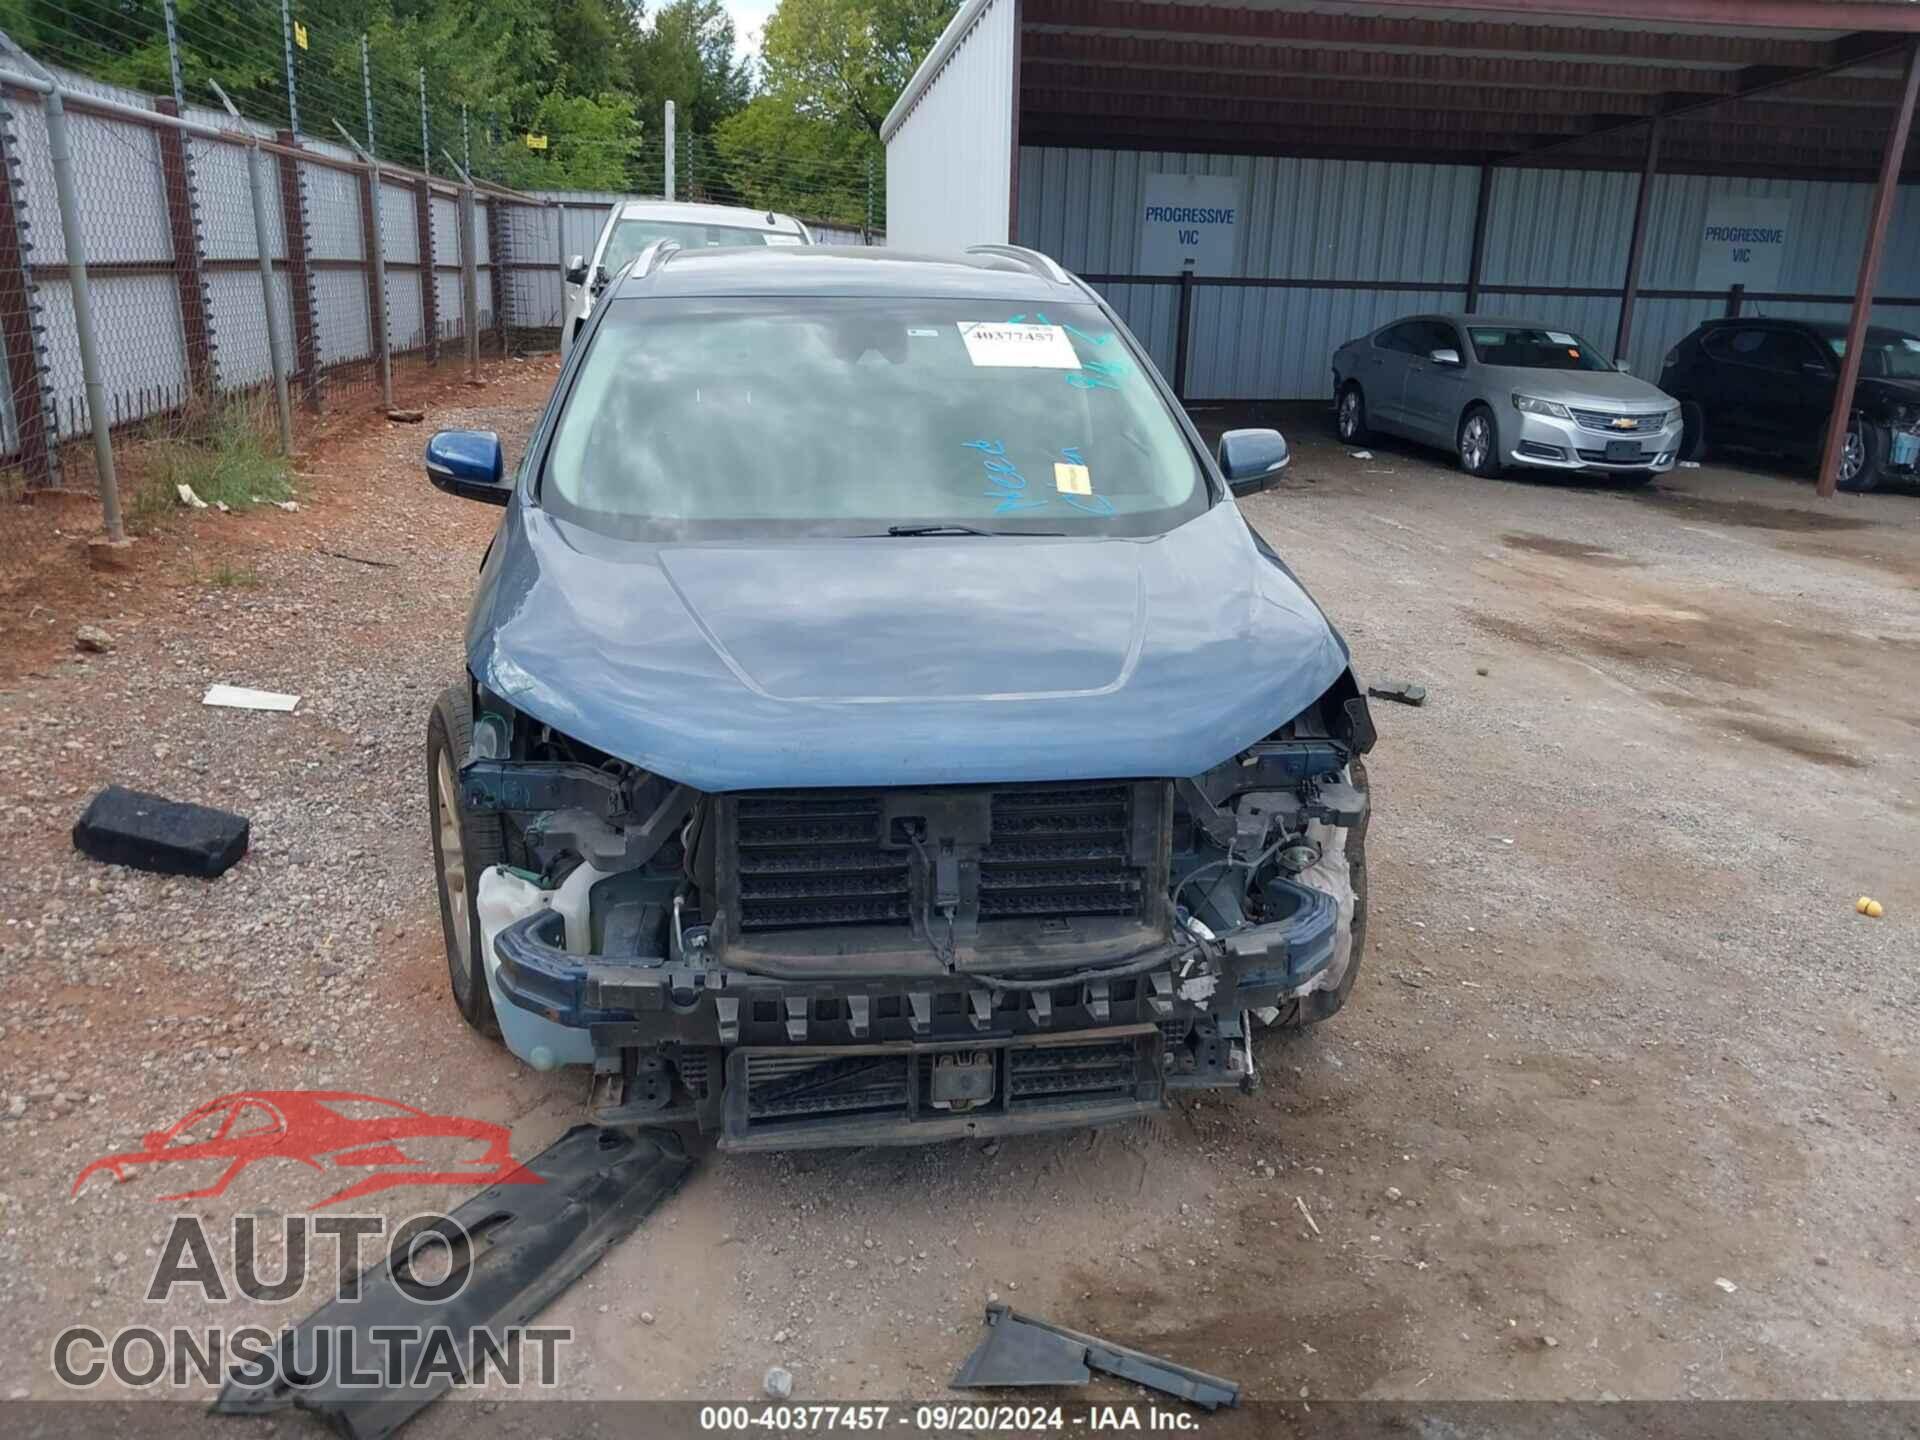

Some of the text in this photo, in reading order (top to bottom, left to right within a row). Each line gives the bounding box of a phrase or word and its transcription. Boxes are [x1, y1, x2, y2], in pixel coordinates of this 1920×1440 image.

[1145, 206, 1235, 224] PROGRESSIVE
[1178, 229, 1200, 245] VIC
[1705, 226, 1784, 244] PROGRESSIVE
[1732, 248, 1751, 263] VIC
